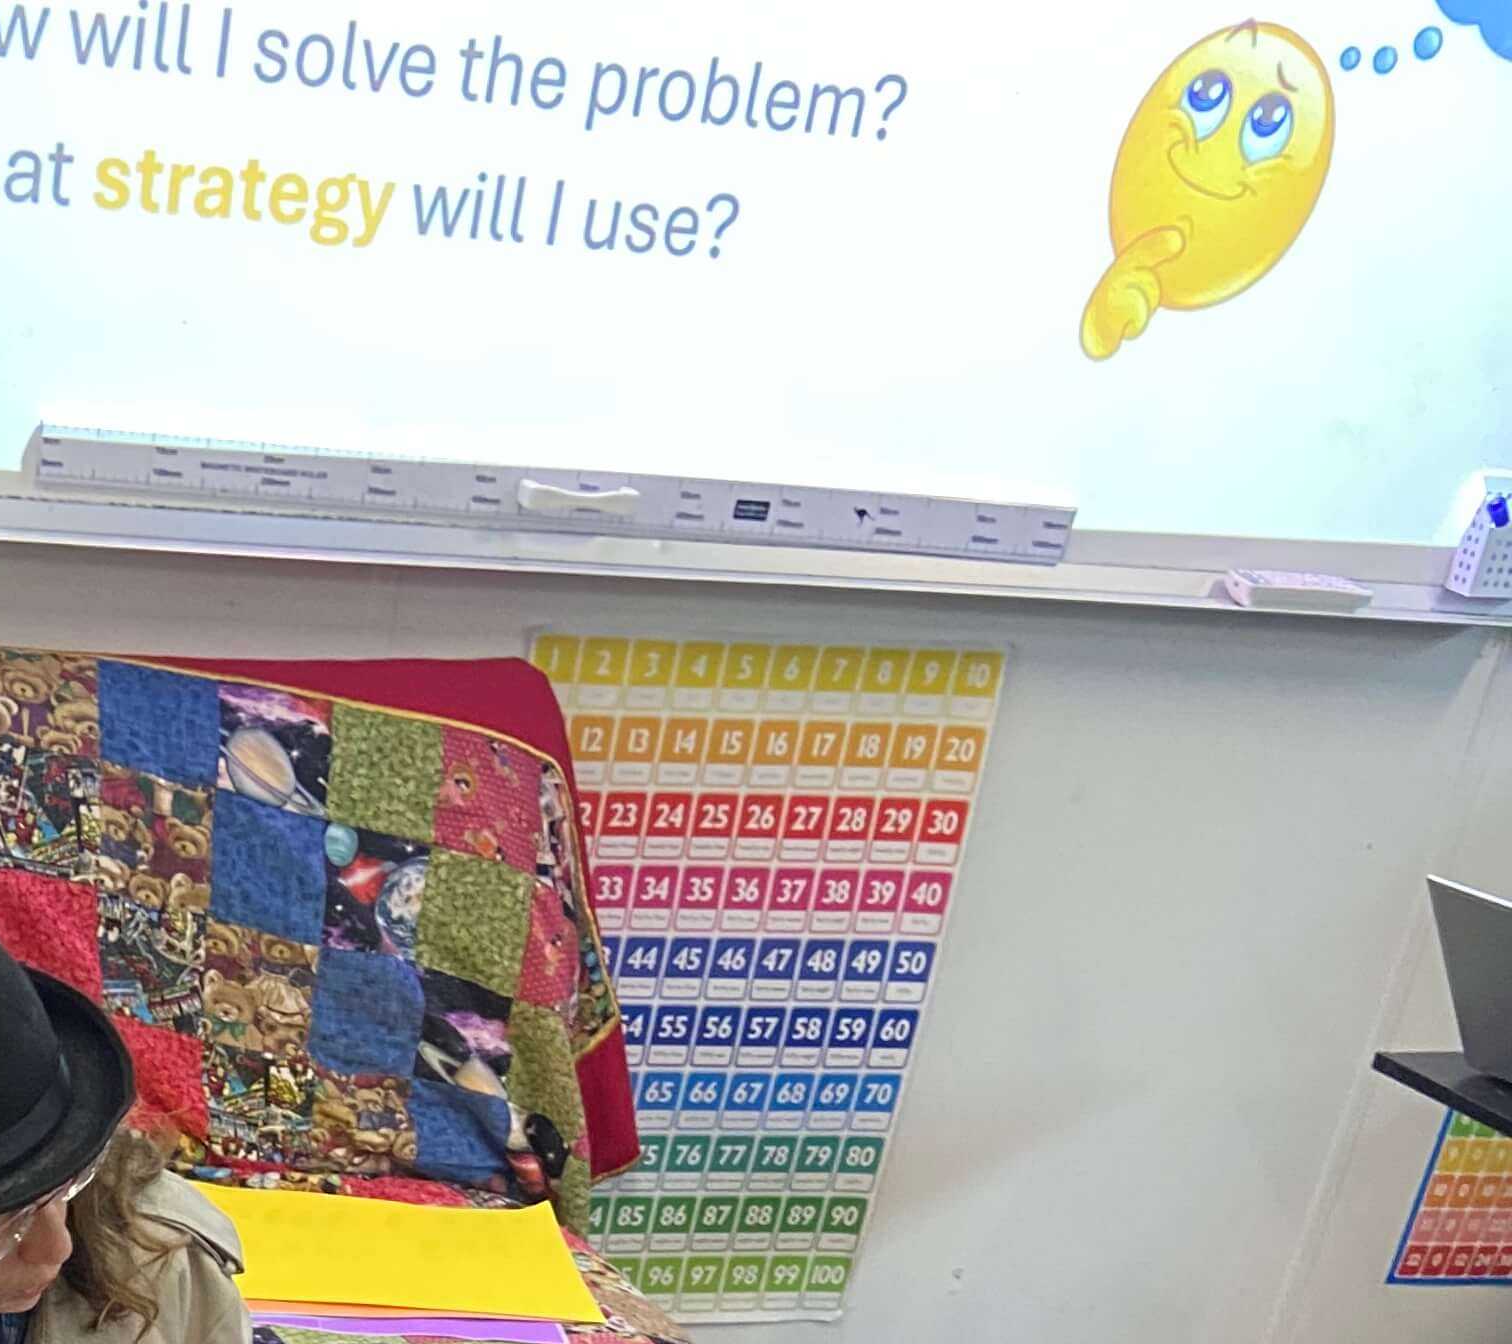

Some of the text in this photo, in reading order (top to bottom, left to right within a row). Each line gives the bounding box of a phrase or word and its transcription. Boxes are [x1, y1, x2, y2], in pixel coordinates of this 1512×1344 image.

[69, 2, 194, 76] will
[213, 11, 231, 78] I
[253, 20, 436, 98] solve
[459, 34, 567, 110] the
[584, 56, 908, 142] problem?
[93, 149, 397, 248] strategy
[413, 171, 526, 243] will
[545, 179, 565, 247] I
[583, 192, 740, 259] use?
[581, 727, 975, 761] 12 13 14 15 16 17 18 19 20
[608, 803, 958, 834] 23 24 25 26 27 28 29 30
[596, 876, 942, 905] 33 34 35 36 37 38 39 40
[627, 947, 926, 973] 44 45 46 47 48 49 50
[659, 1016, 910, 1040] 55 56 57 58 59 60
[645, 1082, 891, 1104] 65 66 67 68 69 70
[811, 1266, 844, 1283] 100
